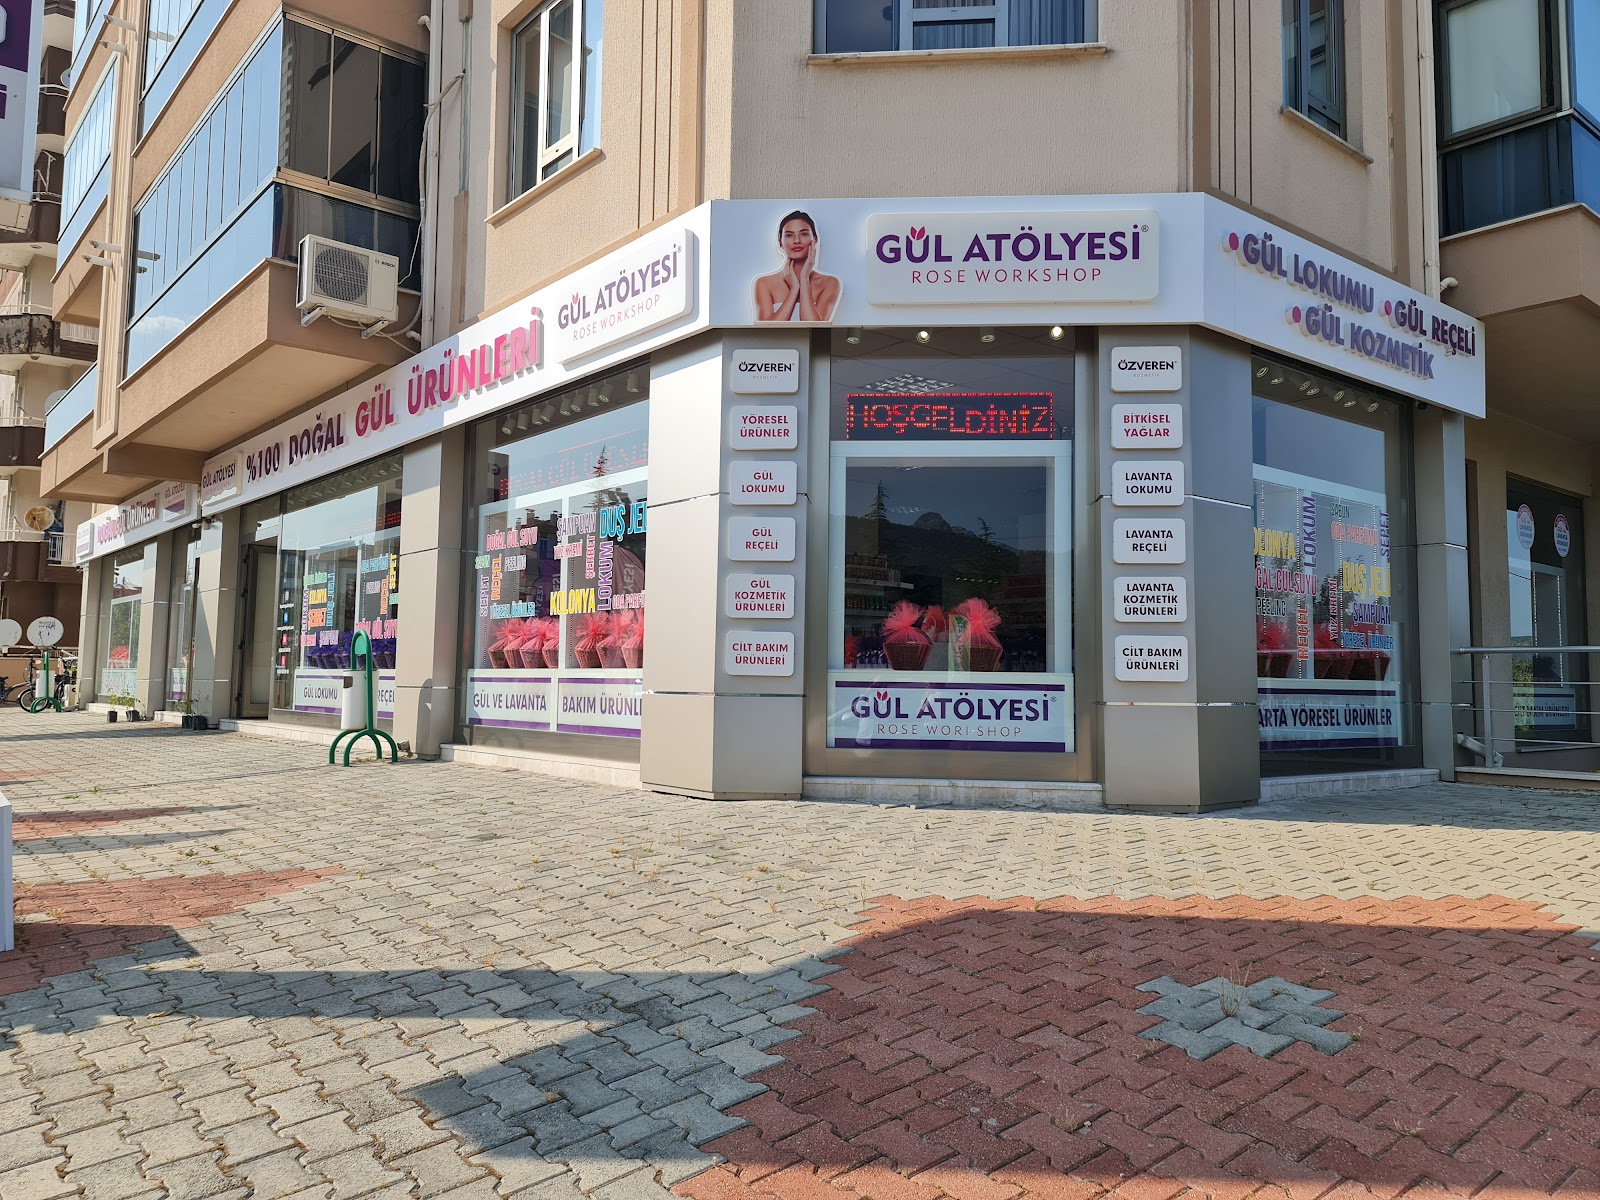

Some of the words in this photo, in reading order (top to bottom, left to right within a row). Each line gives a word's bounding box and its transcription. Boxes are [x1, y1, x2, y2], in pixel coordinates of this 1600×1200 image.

[876, 226, 953, 263] GÜL
[962, 224, 1140, 262] ATÖLYESİ
[912, 269, 966, 284] ROSE
[975, 267, 1102, 283] WORKSHOP
[1243, 231, 1287, 278] GÜL
[1293, 253, 1375, 313] LOKUMU
[558, 291, 590, 330] GÜL
[594, 243, 678, 314] ATÖLYESİ
[573, 322, 597, 341] ROSE
[600, 294, 660, 331] WORKSHOP
[1394, 298, 1427, 336] GÜL
[1431, 315, 1476, 356] REÇELİ
[1305, 303, 1344, 345] GÜL
[1350, 322, 1435, 380] KOZMETİK
[739, 361, 792, 372] ÖZVEREN
[1118, 359, 1175, 371] ÖZVEREN
[246, 442, 281, 483] %100
[289, 412, 345, 465] DOĞAL
[355, 383, 394, 437] GÜL
[407, 306, 540, 415] ÜRÜNLERİ
[742, 413, 788, 425] YÖRESEL
[1123, 412, 1171, 424] BİTKİSEL
[740, 427, 790, 438] ÜRÜNLER
[1124, 425, 1170, 437] YAĞLAR
[753, 470, 773, 481] GÜL
[1125, 472, 1173, 481] LAVANTA
[741, 484, 785, 493] LOKUMU
[1126, 485, 1172, 494] LOKUMU
[1330, 502, 1350, 519] SABUN
[556, 511, 597, 541] ŞAMPUAN
[599, 504, 626, 542] DUŞ
[486, 529, 506, 551] DOĞAL
[507, 527, 519, 549] GÜL
[519, 526, 538, 547] SUYU
[752, 527, 772, 537] GÜL
[1126, 530, 1173, 539] LAVANTA
[1303, 496, 1317, 569] LOKUM
[1330, 521, 1346, 543] ODA
[1380, 510, 1391, 558] SEPET
[745, 540, 778, 551] REÇELİ
[1132, 541, 1167, 554] REÇELİ
[585, 534, 595, 579] ŞERBET
[491, 553, 503, 600] REÇEL
[597, 540, 614, 611] LOKUM
[750, 578, 770, 589] GÜL
[1276, 566, 1293, 593] GÜL
[1342, 562, 1367, 599] DUŞ
[1368, 563, 1391, 597] JELİ
[479, 575, 489, 617] SEPET
[735, 590, 786, 600] KOZMETİK
[1126, 583, 1174, 592] LAVANTA
[549, 588, 595, 615] KOLONYA
[735, 601, 785, 612] ÜRÜNLERİ
[1123, 593, 1178, 604] KOZMETİK
[1257, 597, 1286, 617] PEELING
[1124, 604, 1177, 616] ÜRÜNLERİ
[1353, 602, 1391, 627] ŞAMPUAN
[1296, 603, 1310, 661] REÇEL
[732, 641, 753, 652] CİLT
[756, 643, 789, 652] BAKIM
[1122, 645, 1144, 657] CİLT
[1147, 648, 1182, 657] BAKIM
[735, 654, 785, 665] ÜRÜNLERİ
[1126, 659, 1179, 671] ÜRÜNLERİ
[304, 684, 314, 698] GÜL
[315, 688, 338, 700] LOKUMU
[473, 689, 490, 708] GÜL
[492, 694, 503, 709] VE
[505, 694, 547, 711] LAVANTA
[562, 696, 596, 714] BAKIM
[851, 690, 908, 719] GÜL
[916, 692, 1049, 722] ATÖLYESİ
[1291, 704, 1341, 727] YÖRESEL
[1344, 704, 1392, 726] ÜRÜNLER
[877, 723, 918, 736] ROSE
